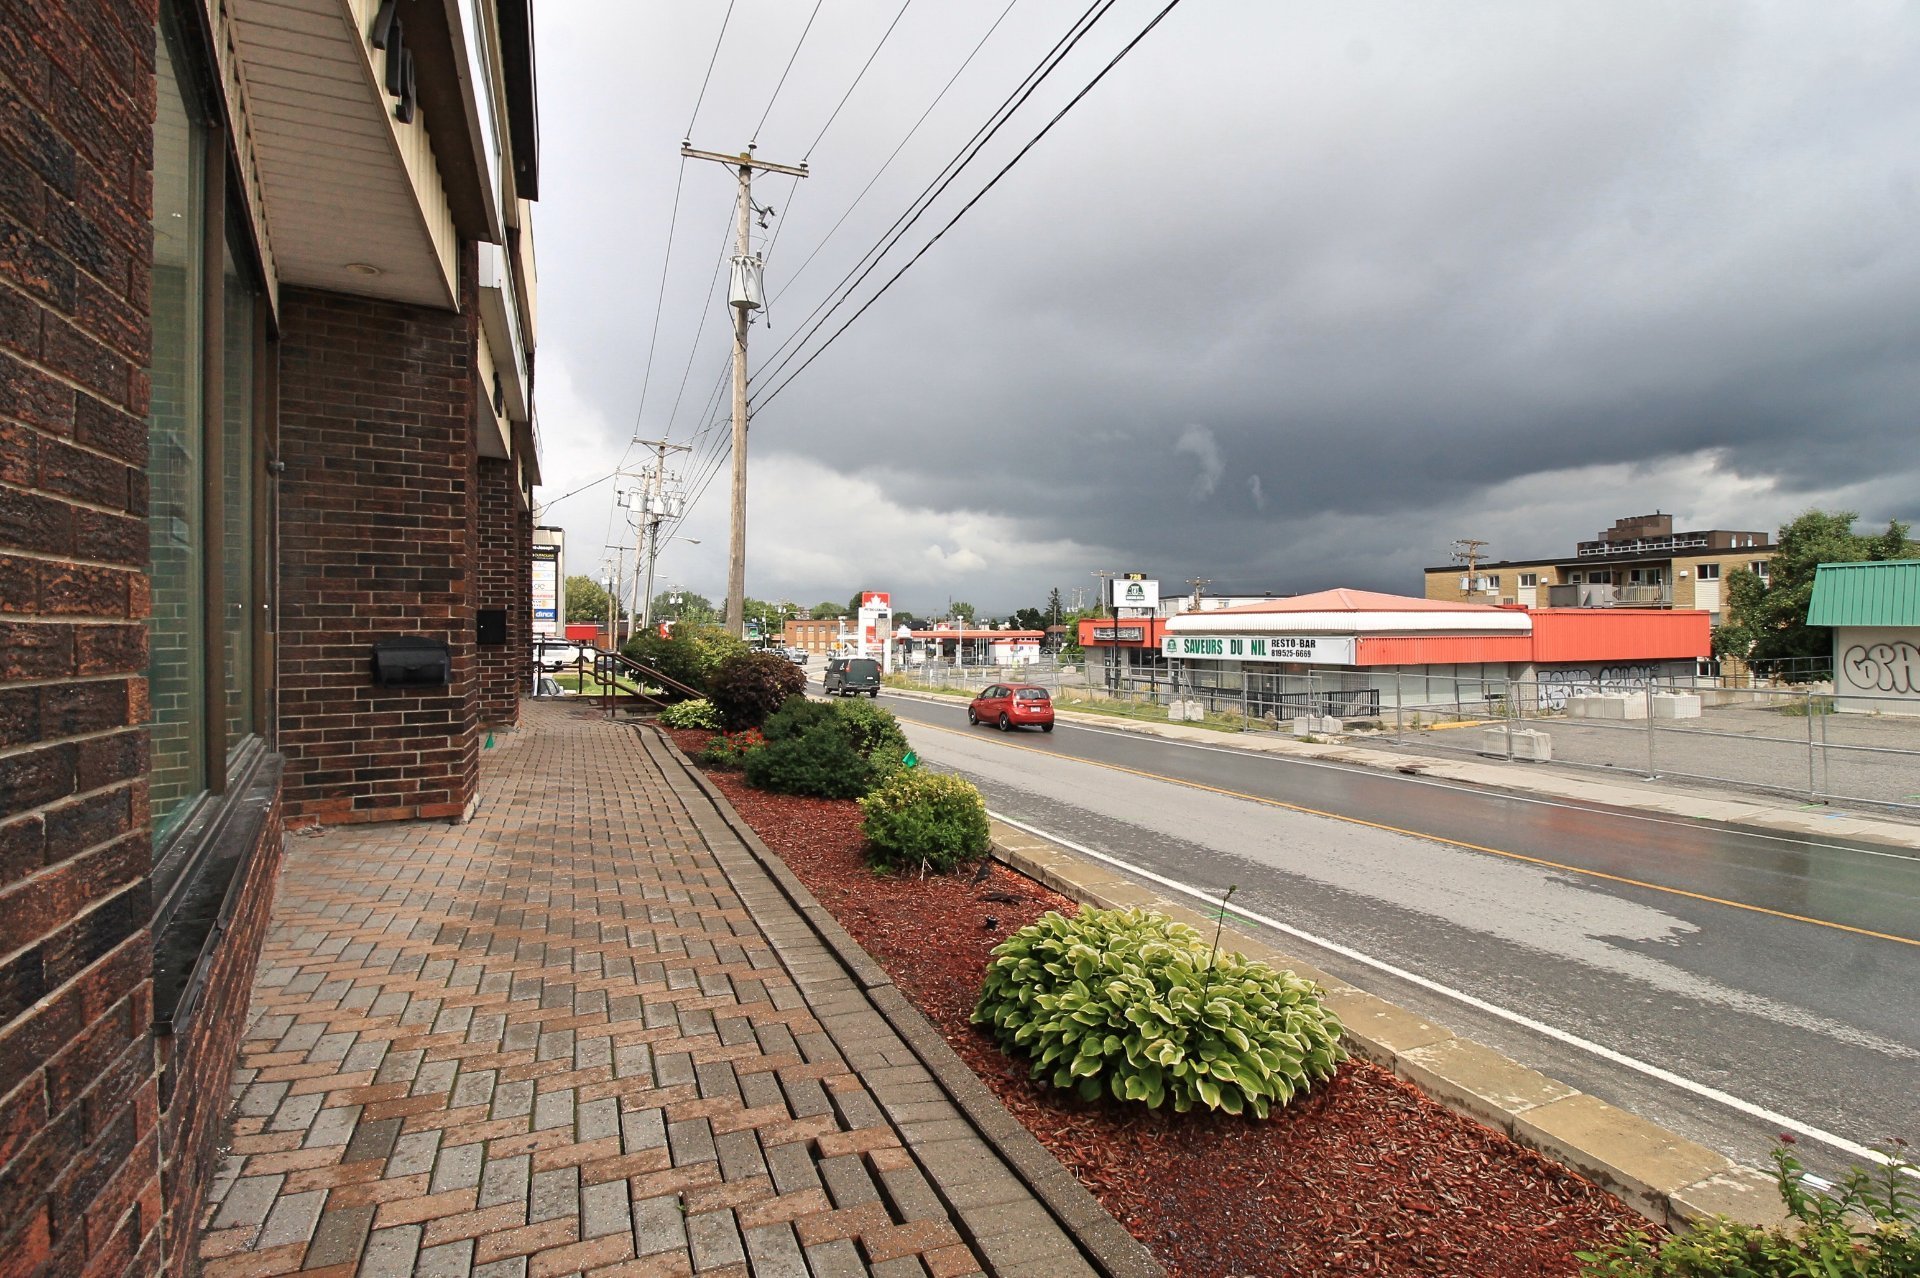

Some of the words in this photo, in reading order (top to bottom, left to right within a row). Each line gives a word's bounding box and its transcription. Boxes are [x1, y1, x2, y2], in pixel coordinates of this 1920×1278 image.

[1184, 638, 1223, 655] SAVEURS
[1230, 639, 1243, 656] DU
[1250, 639, 1267, 656] NIL
